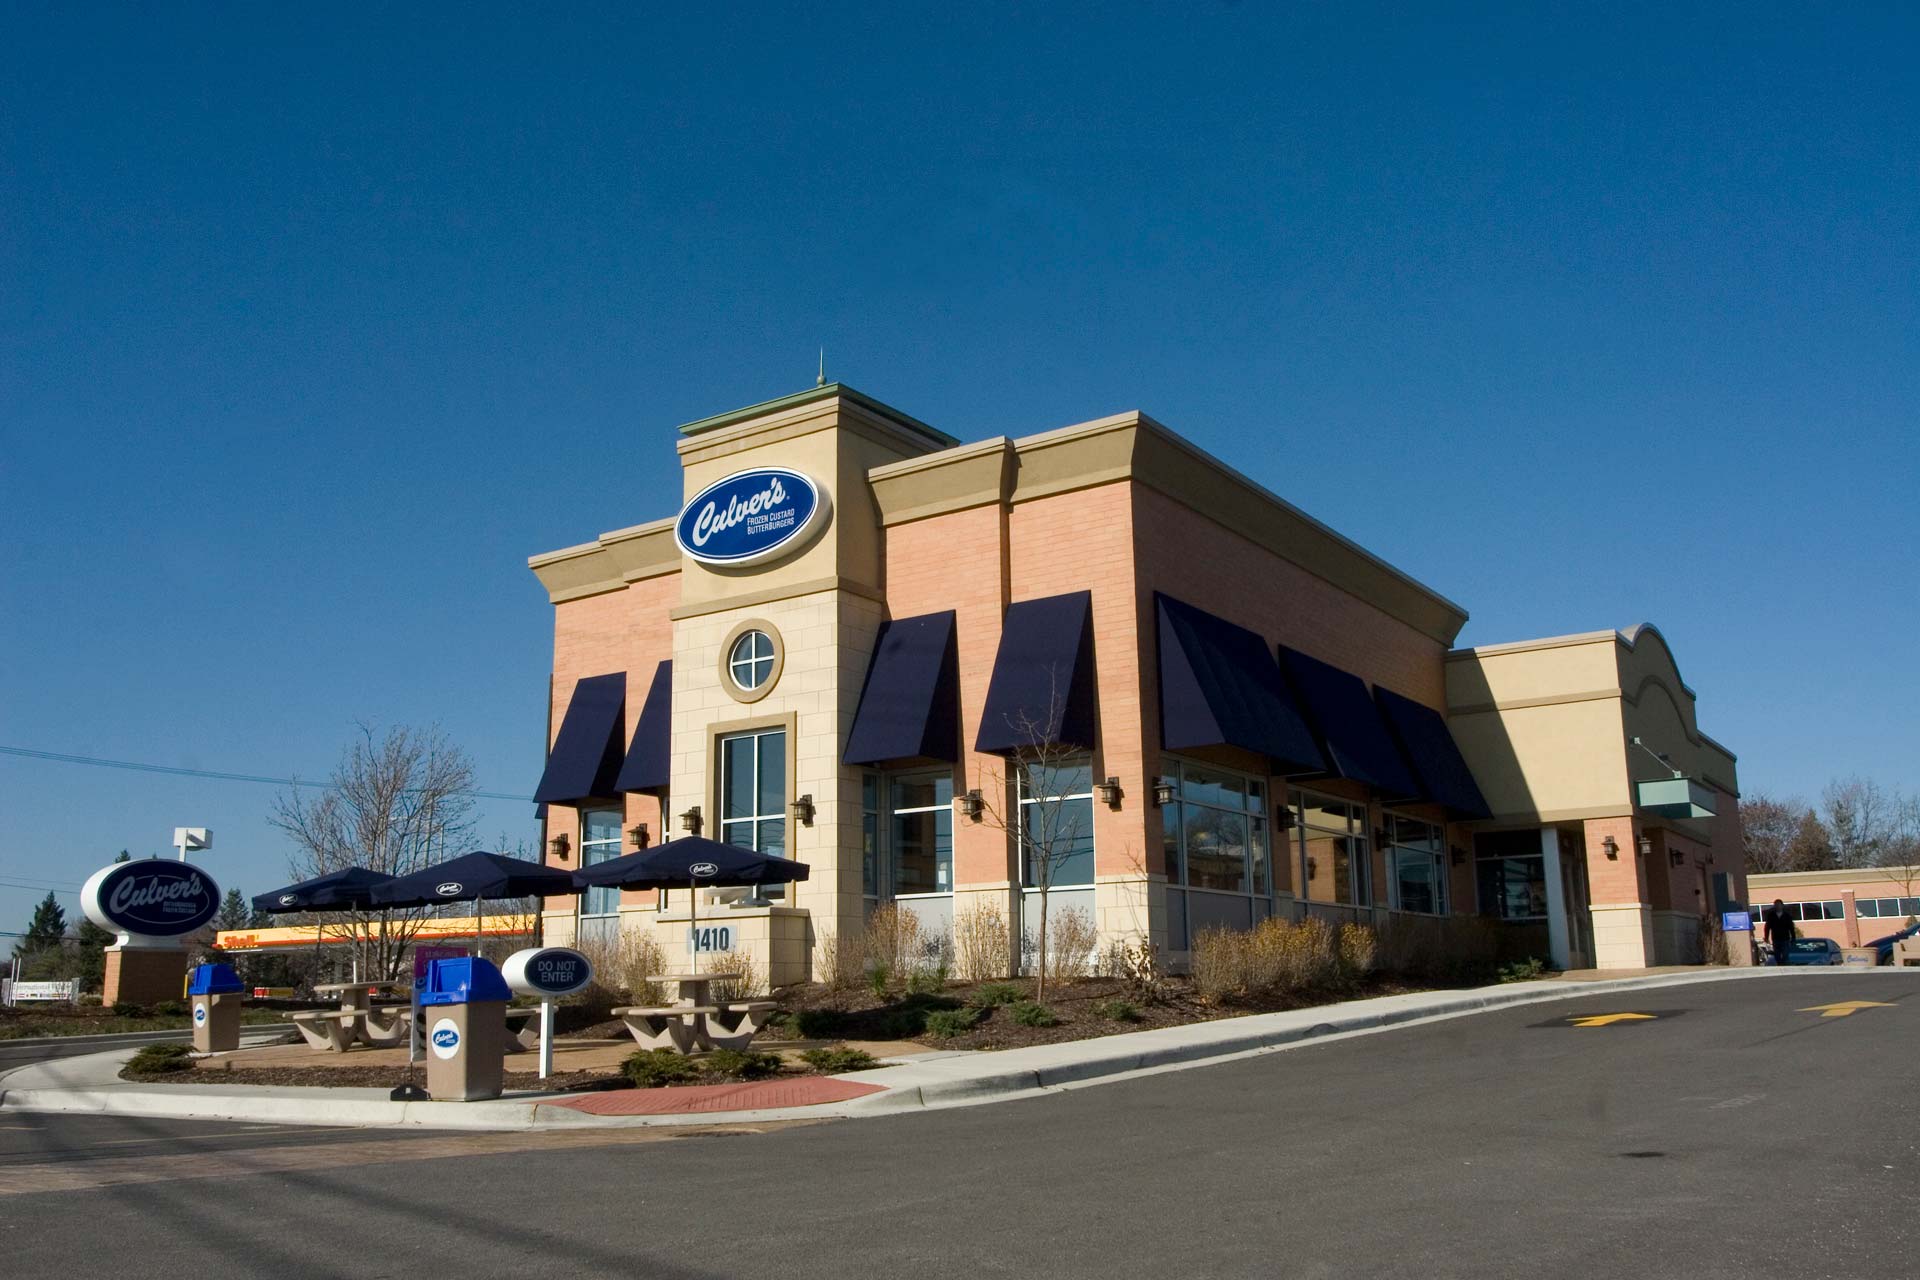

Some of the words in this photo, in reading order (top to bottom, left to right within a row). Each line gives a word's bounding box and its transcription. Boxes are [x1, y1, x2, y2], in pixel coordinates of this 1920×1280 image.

[692, 477, 786, 547] Culver's
[747, 514, 768, 526] FROZEN
[769, 508, 795, 521] CUSTARD
[109, 872, 204, 914] Culver's
[224, 935, 256, 948] Shell
[694, 927, 730, 952] 1410
[537, 960, 554, 972] DO
[556, 960, 577, 972] NOT
[541, 971, 574, 983] ENTER
